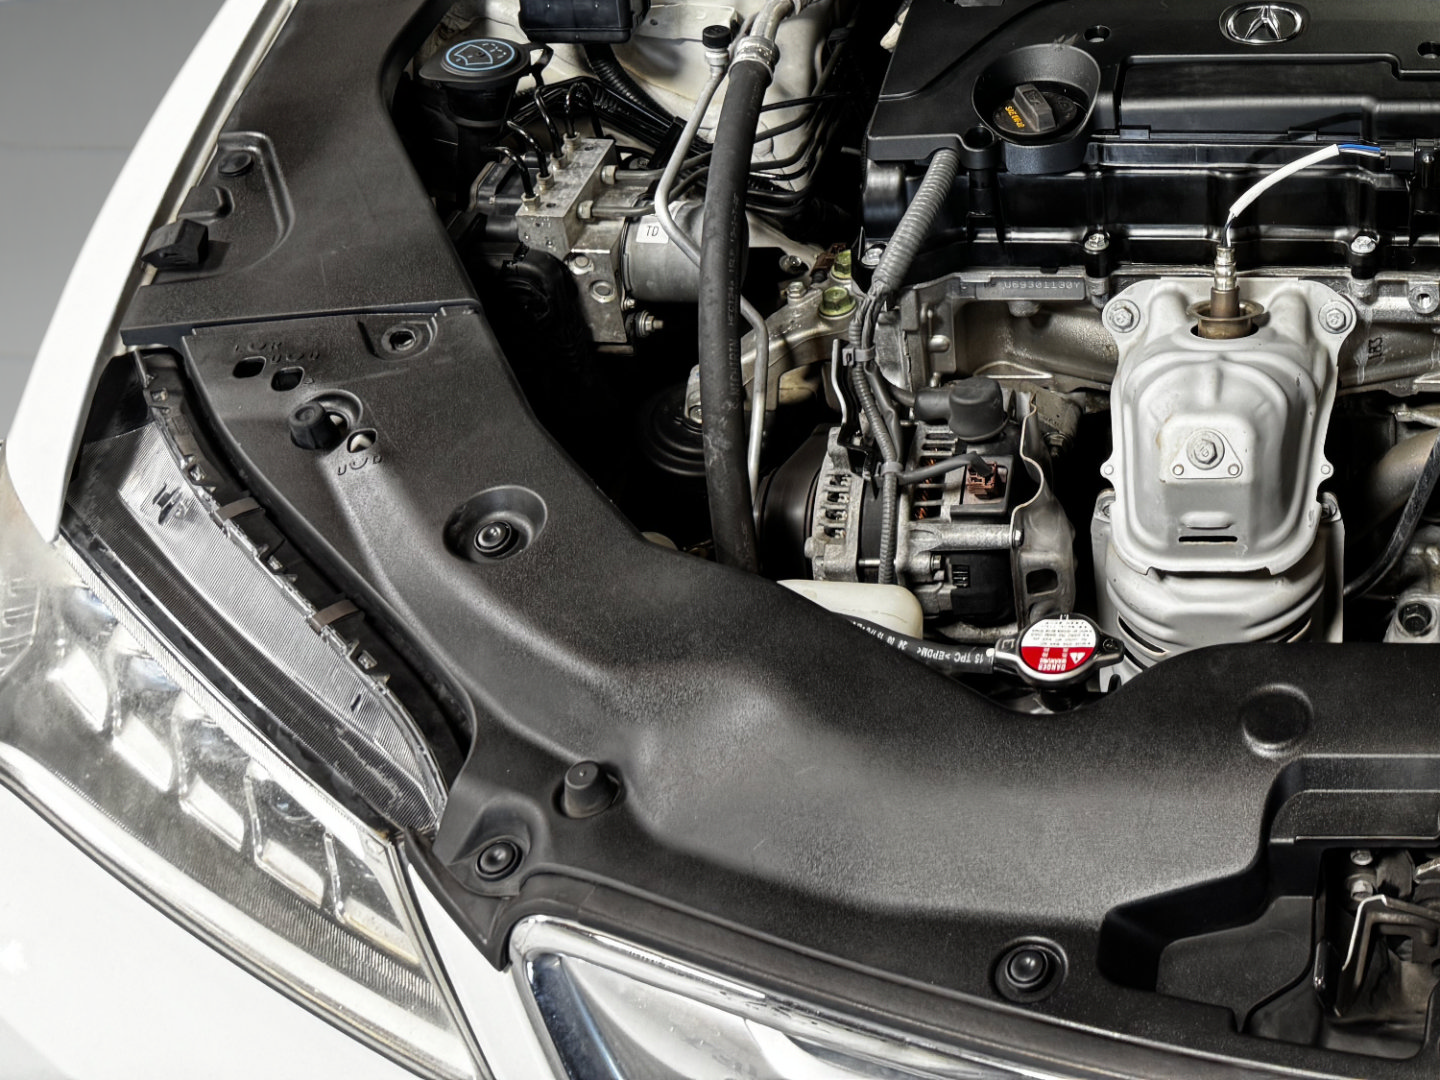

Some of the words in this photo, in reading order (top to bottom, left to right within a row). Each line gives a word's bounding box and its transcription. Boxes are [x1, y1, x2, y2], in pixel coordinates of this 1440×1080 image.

[646, 225, 660, 237] TD
[953, 652, 972, 664] TPC
[1038, 663, 1066, 671] DANGER
